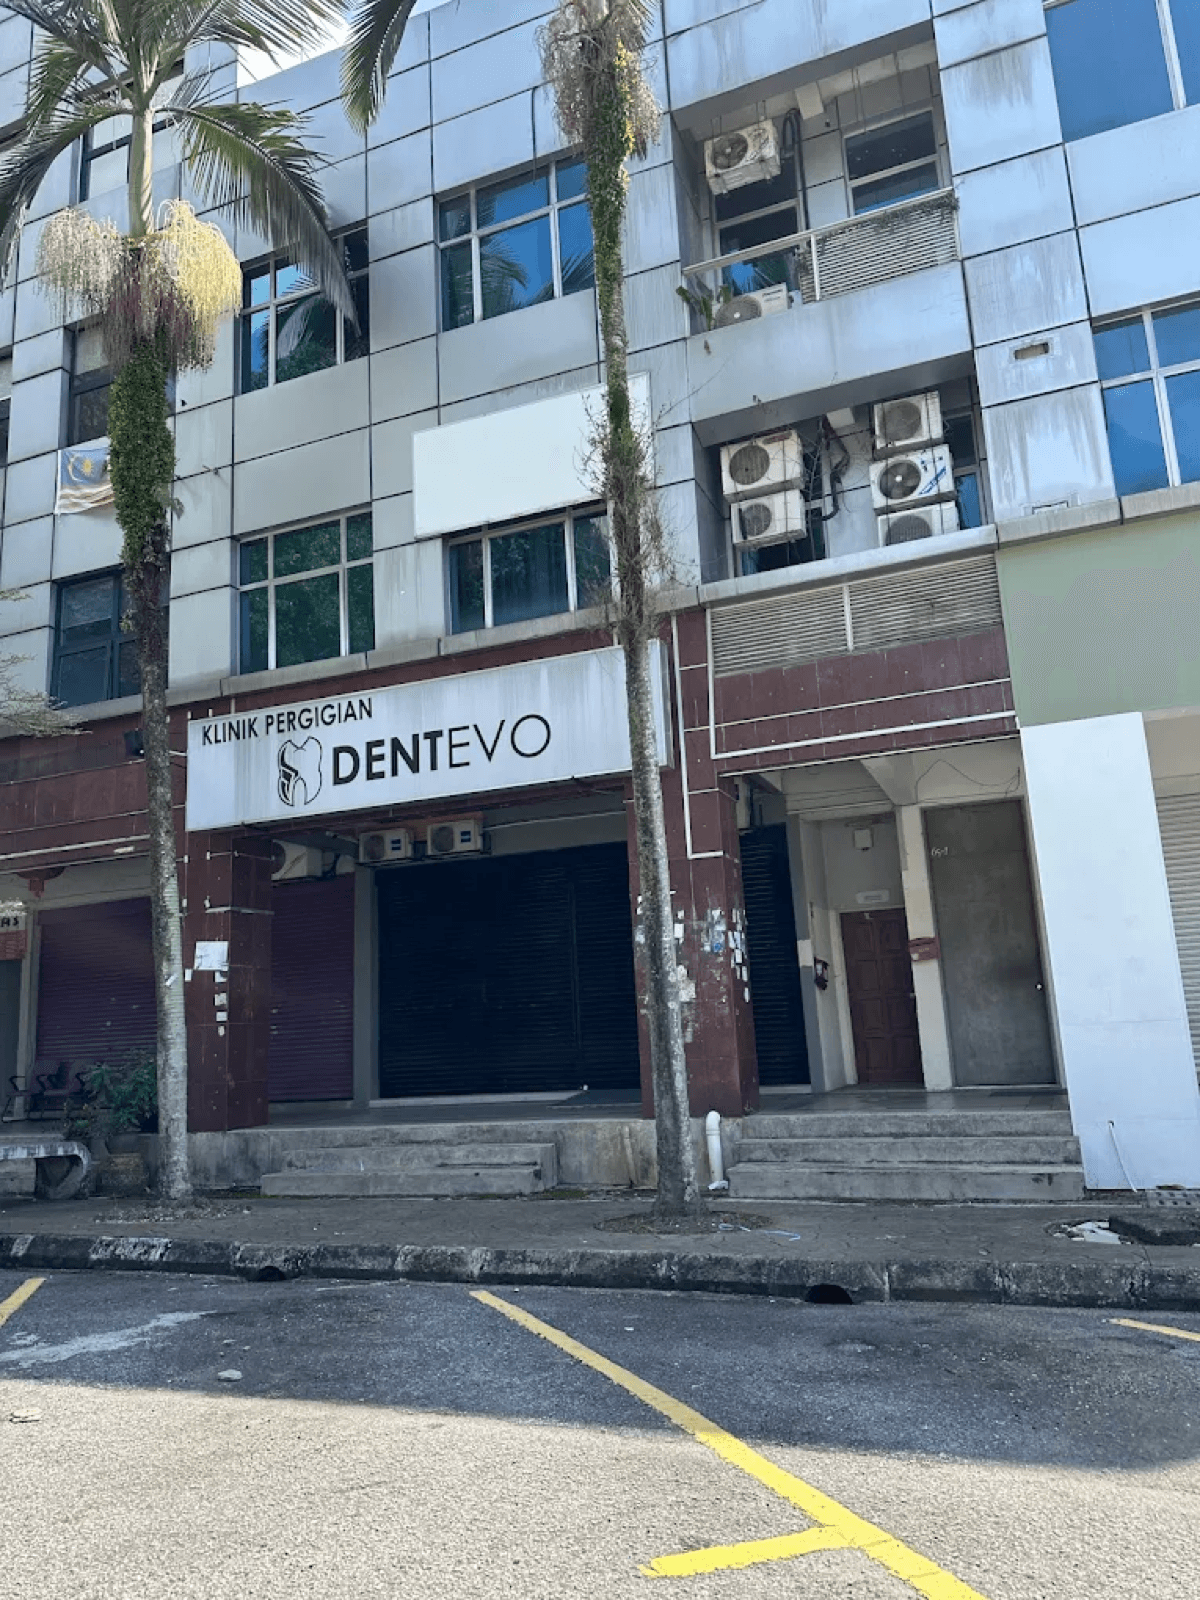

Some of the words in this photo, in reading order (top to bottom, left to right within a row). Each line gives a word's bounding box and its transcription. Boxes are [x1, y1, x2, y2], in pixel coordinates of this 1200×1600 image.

[202, 717, 258, 745] KLINIK
[265, 698, 372, 735] PERGIGIAN
[332, 713, 551, 786] DENTEVO
